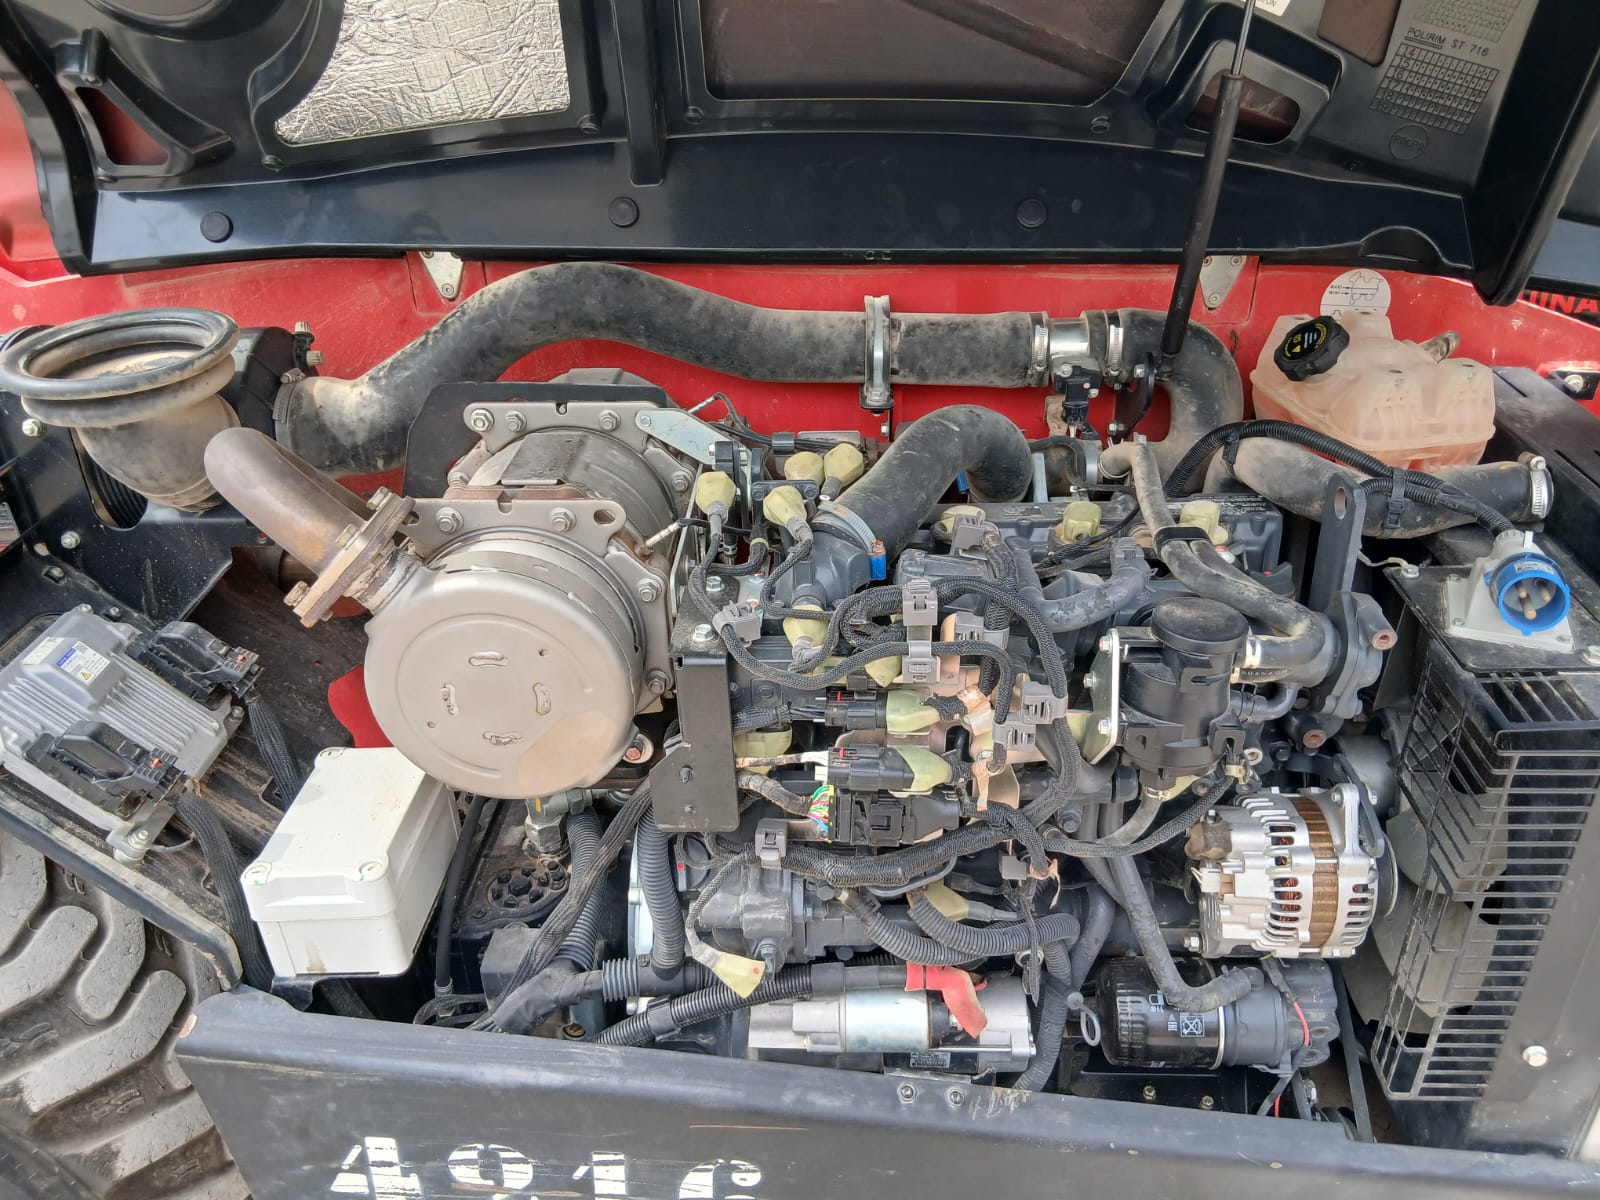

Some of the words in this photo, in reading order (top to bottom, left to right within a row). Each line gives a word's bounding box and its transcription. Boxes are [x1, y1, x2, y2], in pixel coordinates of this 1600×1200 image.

[1407, 27, 1446, 44] POLIRIM
[1451, 39, 1465, 49] ST
[1470, 44, 1489, 56] 716
